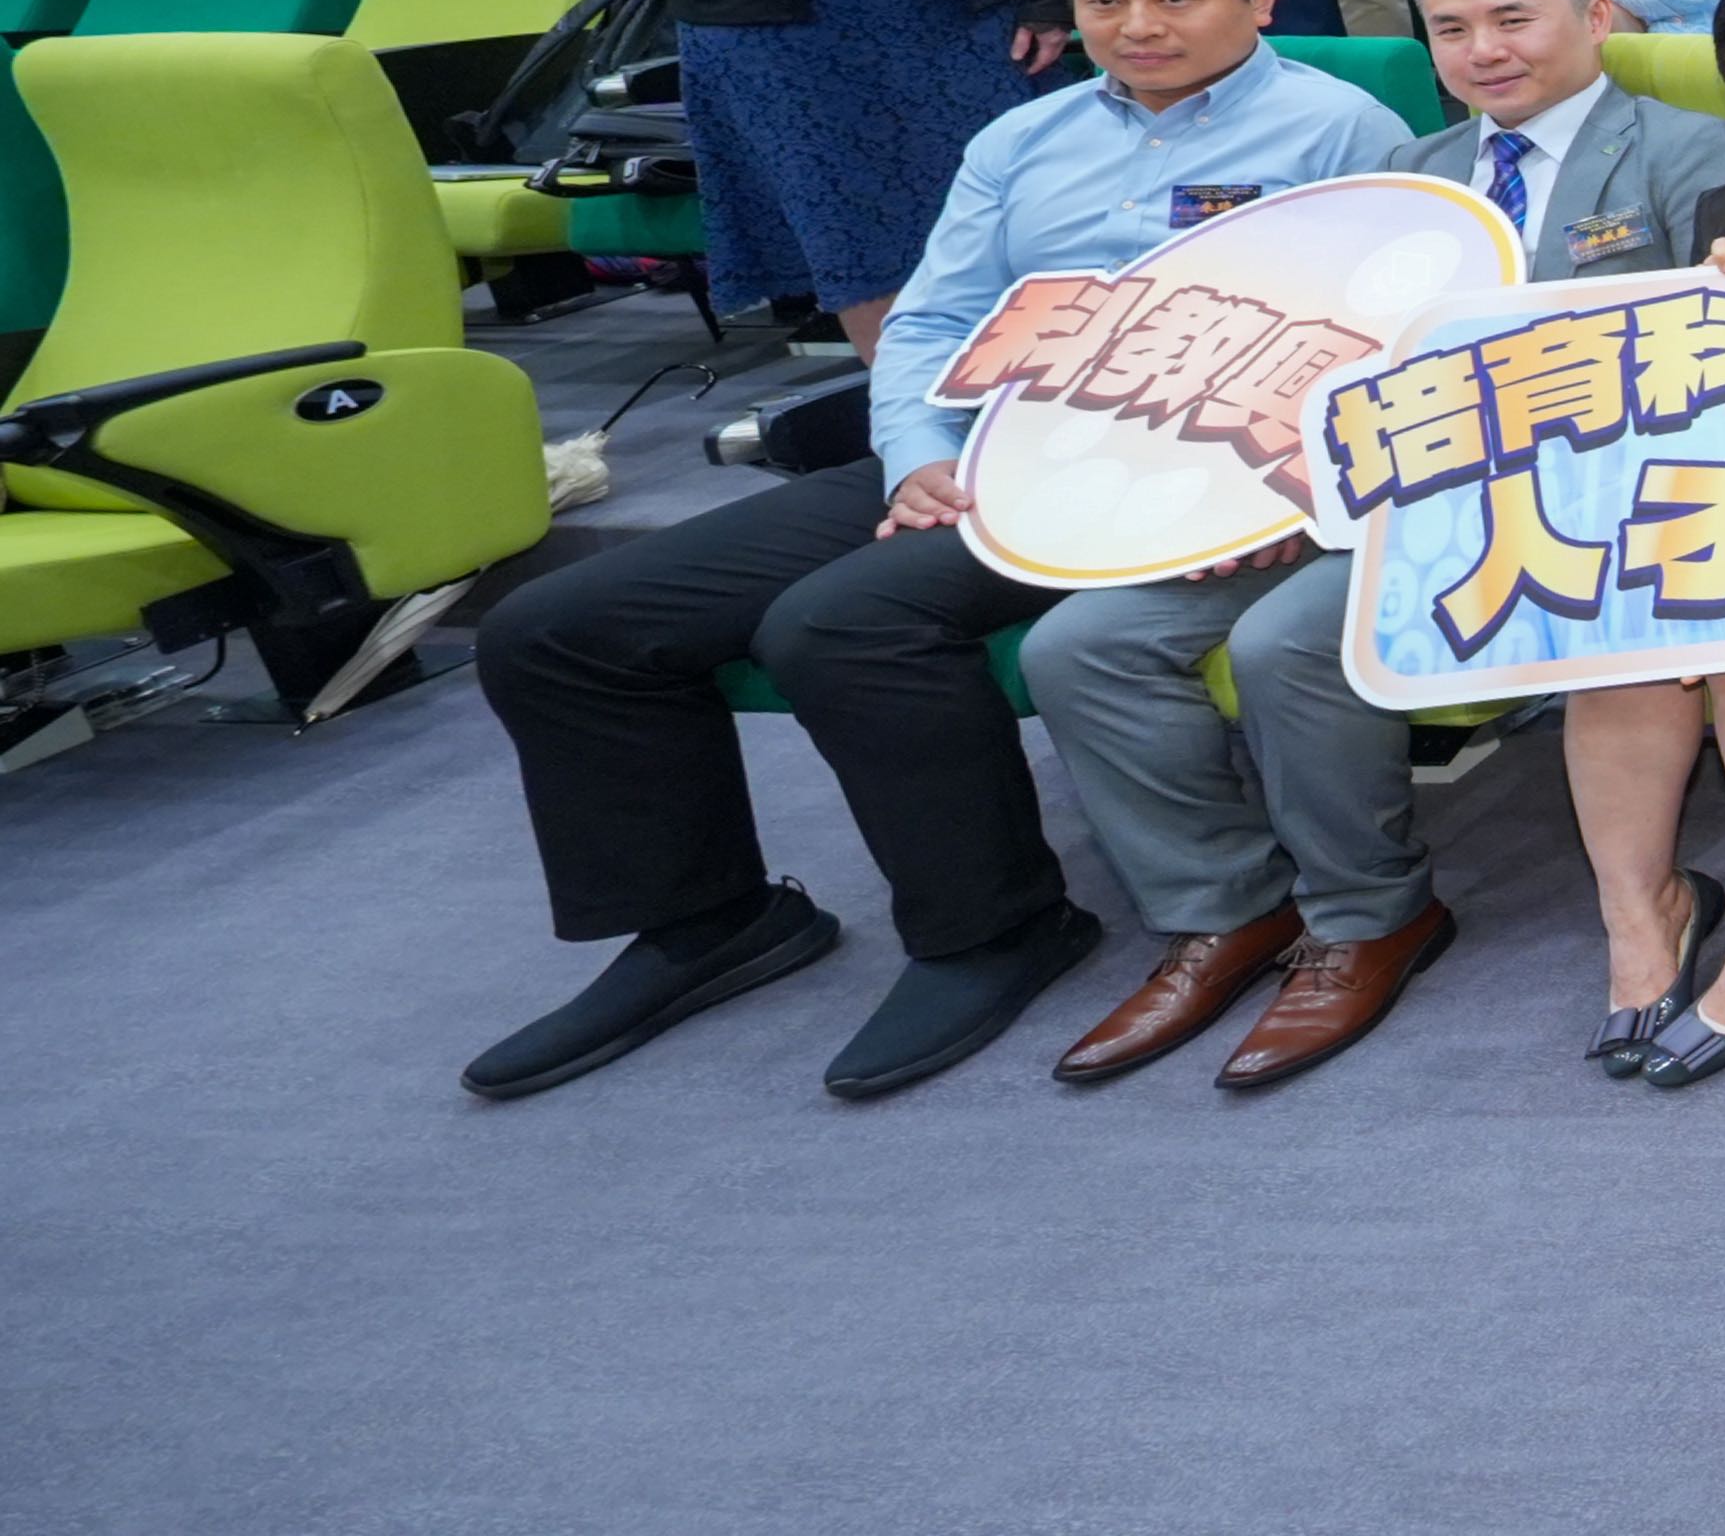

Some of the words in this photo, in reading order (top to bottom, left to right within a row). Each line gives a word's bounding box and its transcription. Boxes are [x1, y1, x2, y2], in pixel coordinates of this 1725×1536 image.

[326, 389, 359, 415] A
[935, 276, 1383, 520] 科教興
